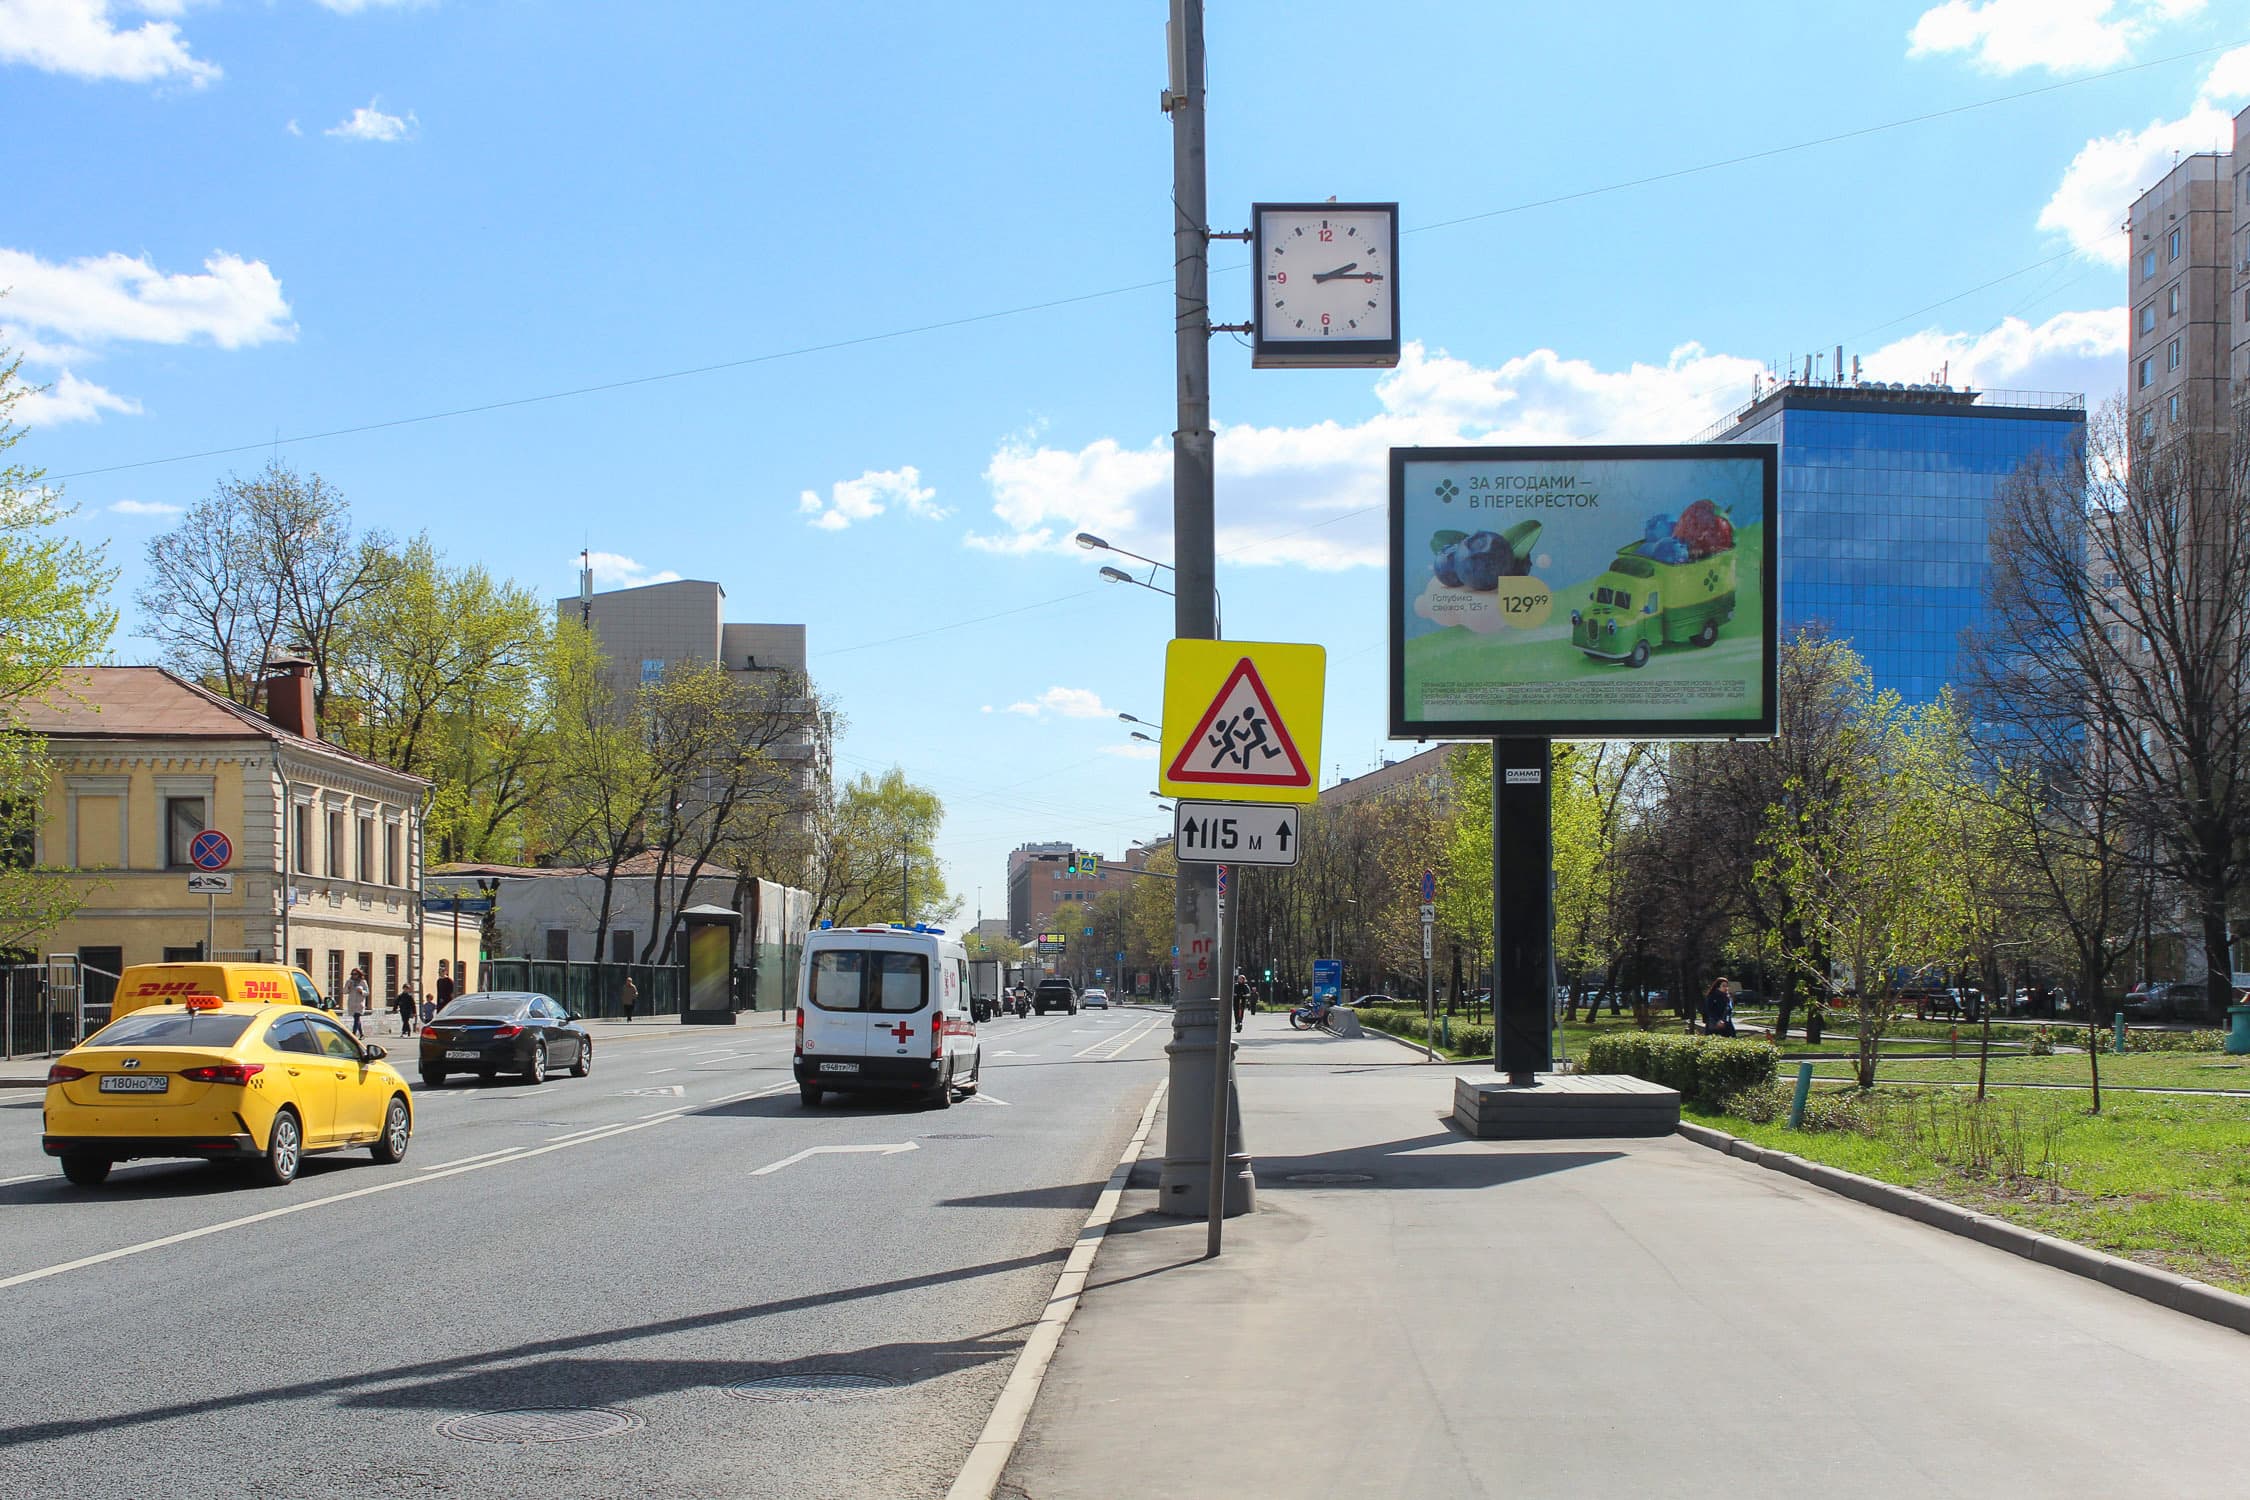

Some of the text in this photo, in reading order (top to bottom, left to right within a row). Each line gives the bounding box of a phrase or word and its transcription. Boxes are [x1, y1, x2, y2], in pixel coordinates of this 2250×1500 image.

[1318, 230, 1333, 242] 12
[1277, 272, 1287, 284] 9
[1321, 313, 1330, 325] 6
[1469, 476, 1490, 489] ЗА
[1495, 475, 1575, 491] ЯГОДАМИ
[1470, 492, 1599, 508] В ПЕРЕКРЁСТОК
[1200, 818, 1239, 849] 115
[137, 982, 204, 997] DHL
[244, 981, 282, 999] DHL
